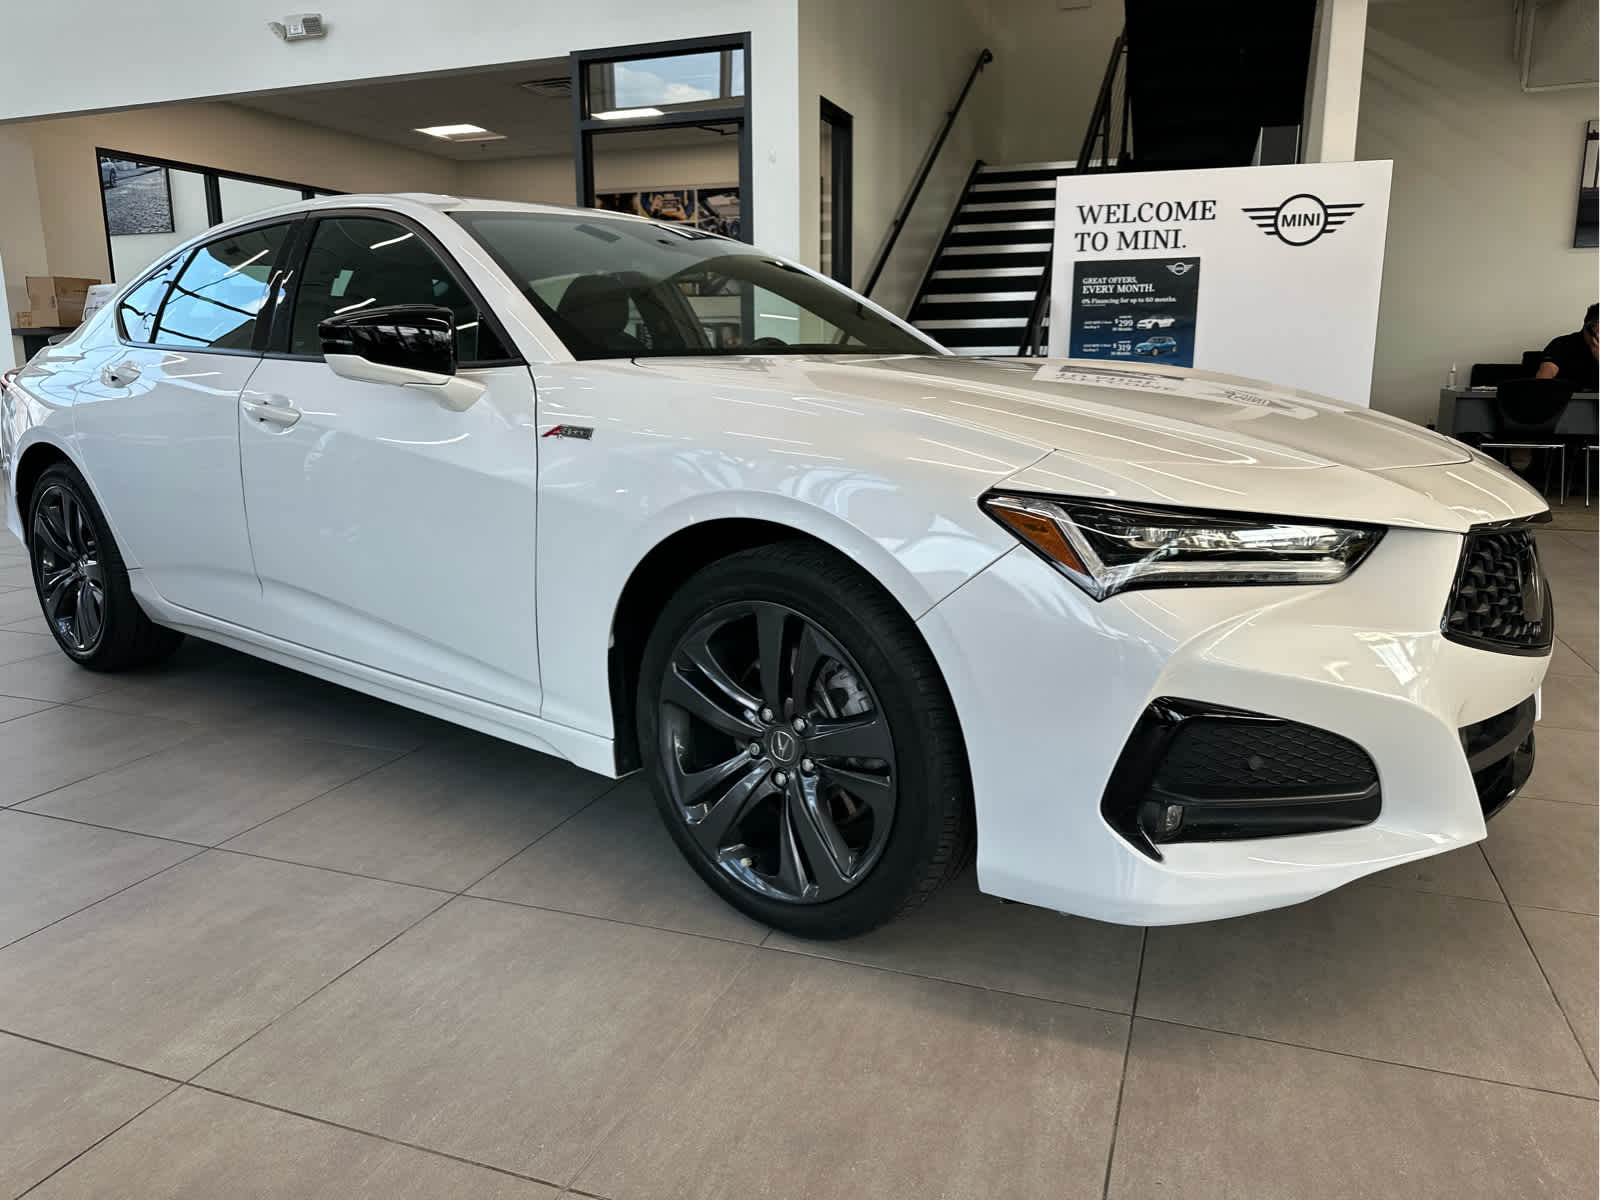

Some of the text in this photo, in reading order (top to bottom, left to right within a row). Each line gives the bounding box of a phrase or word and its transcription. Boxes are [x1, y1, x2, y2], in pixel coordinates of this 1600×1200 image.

[1075, 199, 1217, 225] WELCOME
[1281, 212, 1321, 227] MINI
[1074, 228, 1187, 252] TO MINI.
[1083, 283, 1155, 294] EVERY MONTH.
